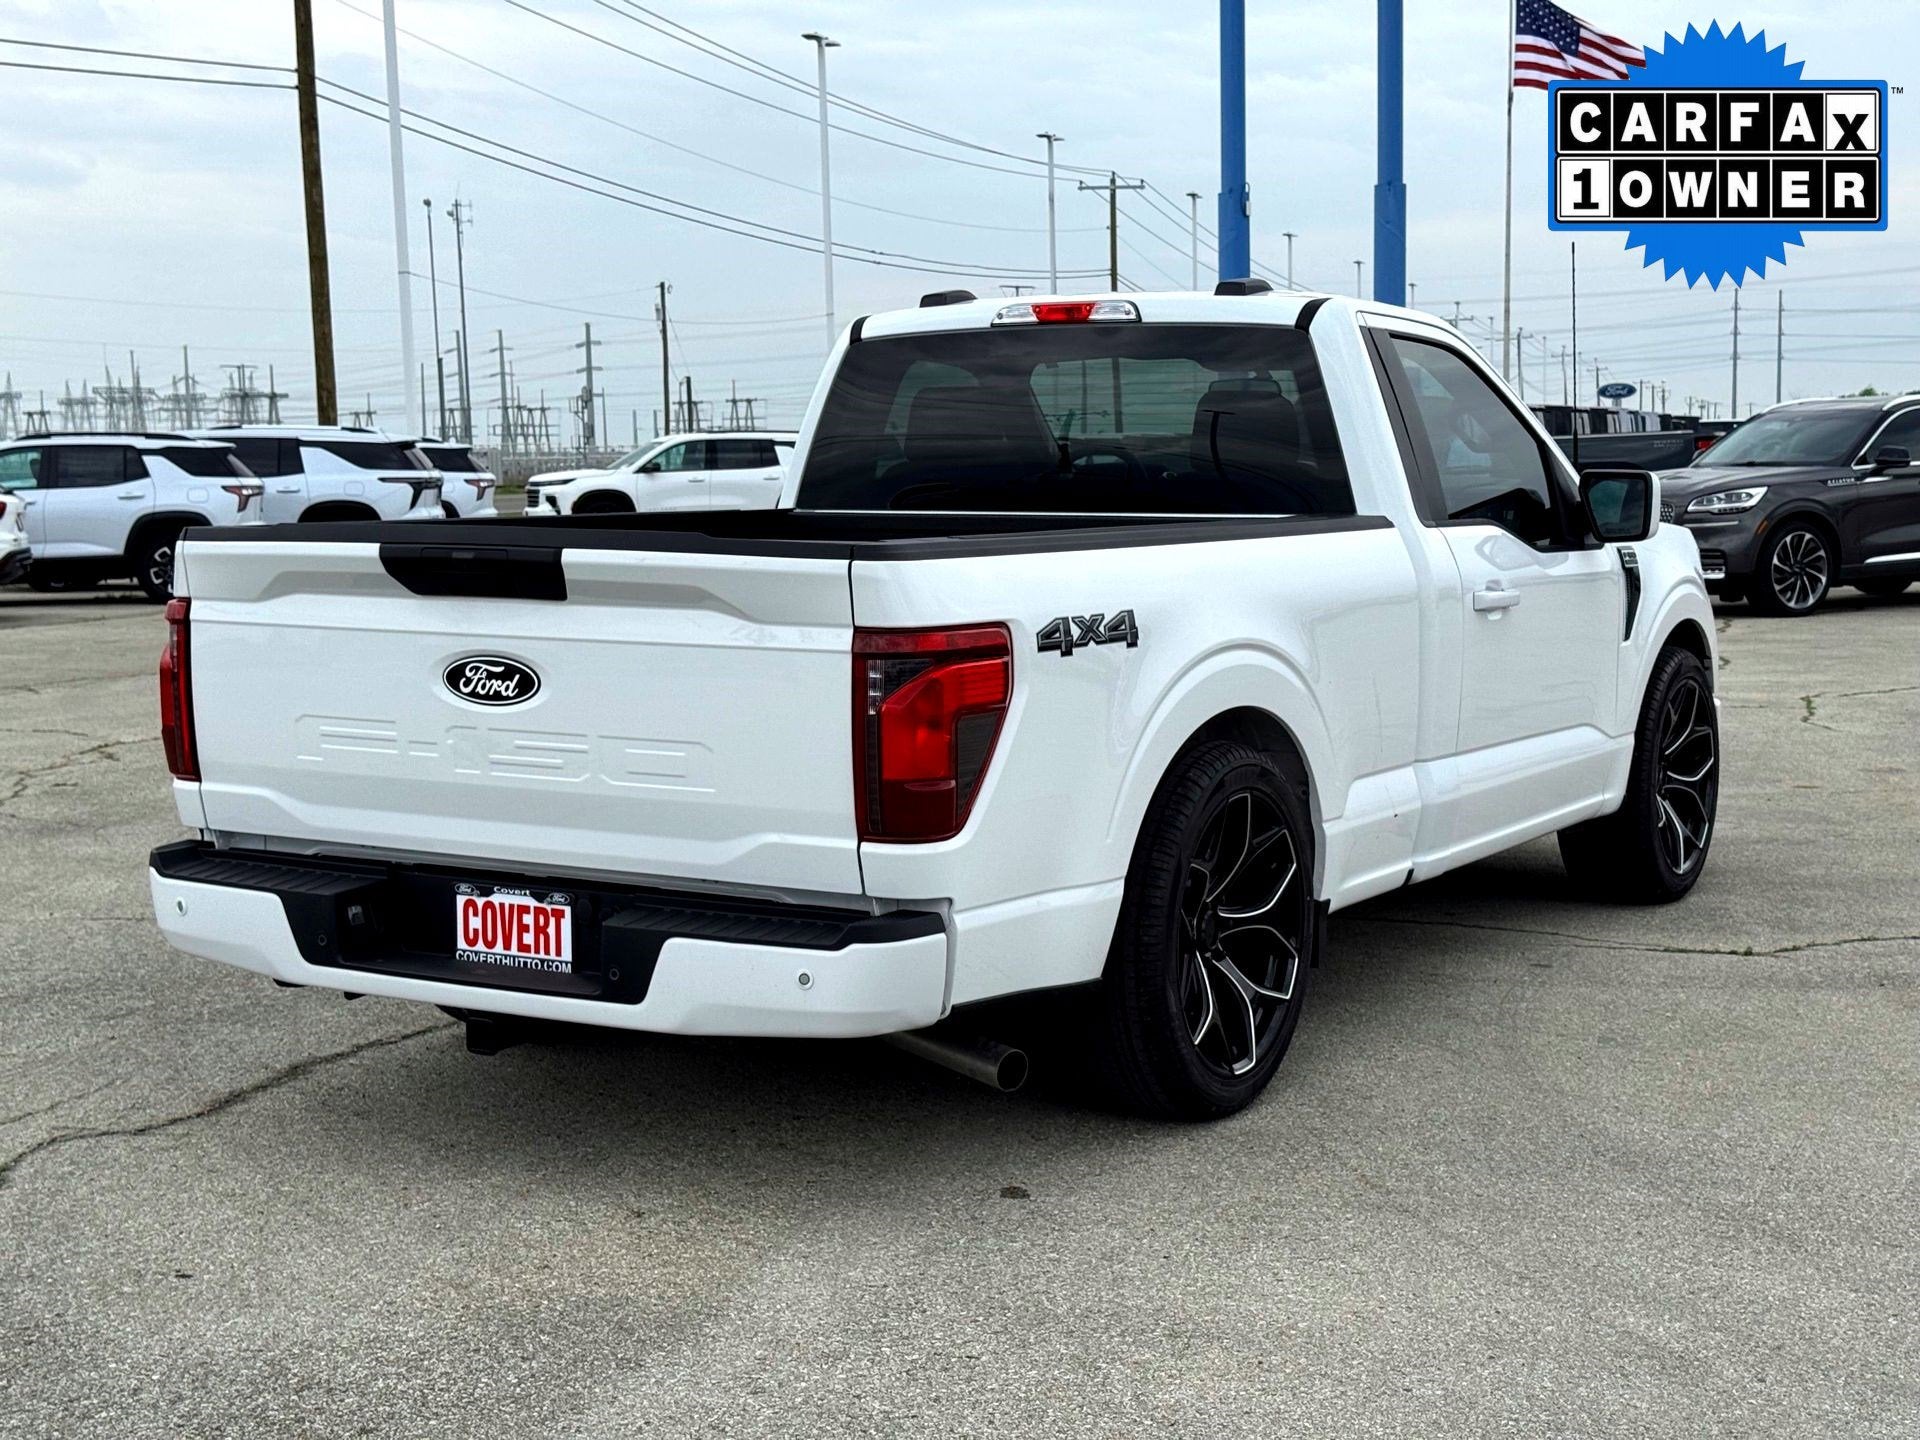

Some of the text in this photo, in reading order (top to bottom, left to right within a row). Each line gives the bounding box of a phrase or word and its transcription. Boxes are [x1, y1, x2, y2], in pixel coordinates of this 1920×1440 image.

[459, 662, 520, 697] Ford
[295, 714, 716, 792] F-150
[493, 886, 531, 897] Covert
[463, 898, 565, 957] COVERT
